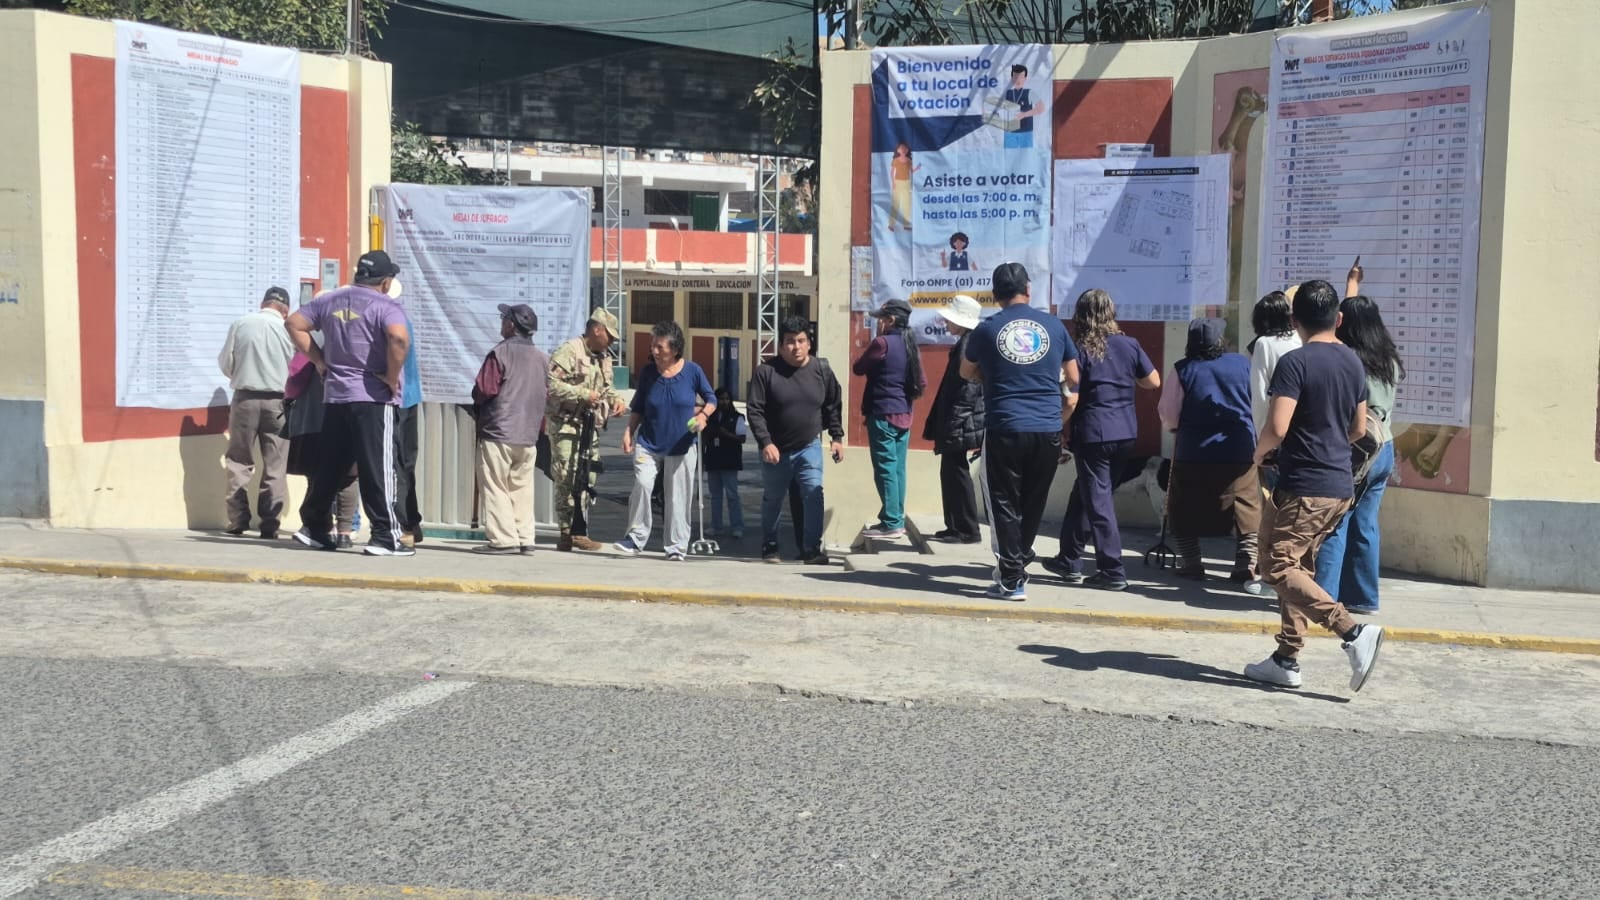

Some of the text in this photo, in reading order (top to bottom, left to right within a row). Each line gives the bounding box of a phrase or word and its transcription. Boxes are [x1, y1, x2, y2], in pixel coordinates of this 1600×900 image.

[897, 56, 991, 73] Bienvenido
[897, 74, 998, 92] a tu local de
[899, 94, 971, 110] votación
[923, 173, 1035, 188] Asiste a votar
[923, 192, 1040, 204] desde las 7:00 a. m.
[923, 208, 1039, 221] hasta las 5:00 p. m.
[901, 279, 925, 287] Fono
[927, 278, 953, 287] ONPE
[955, 276, 974, 289] (01)
